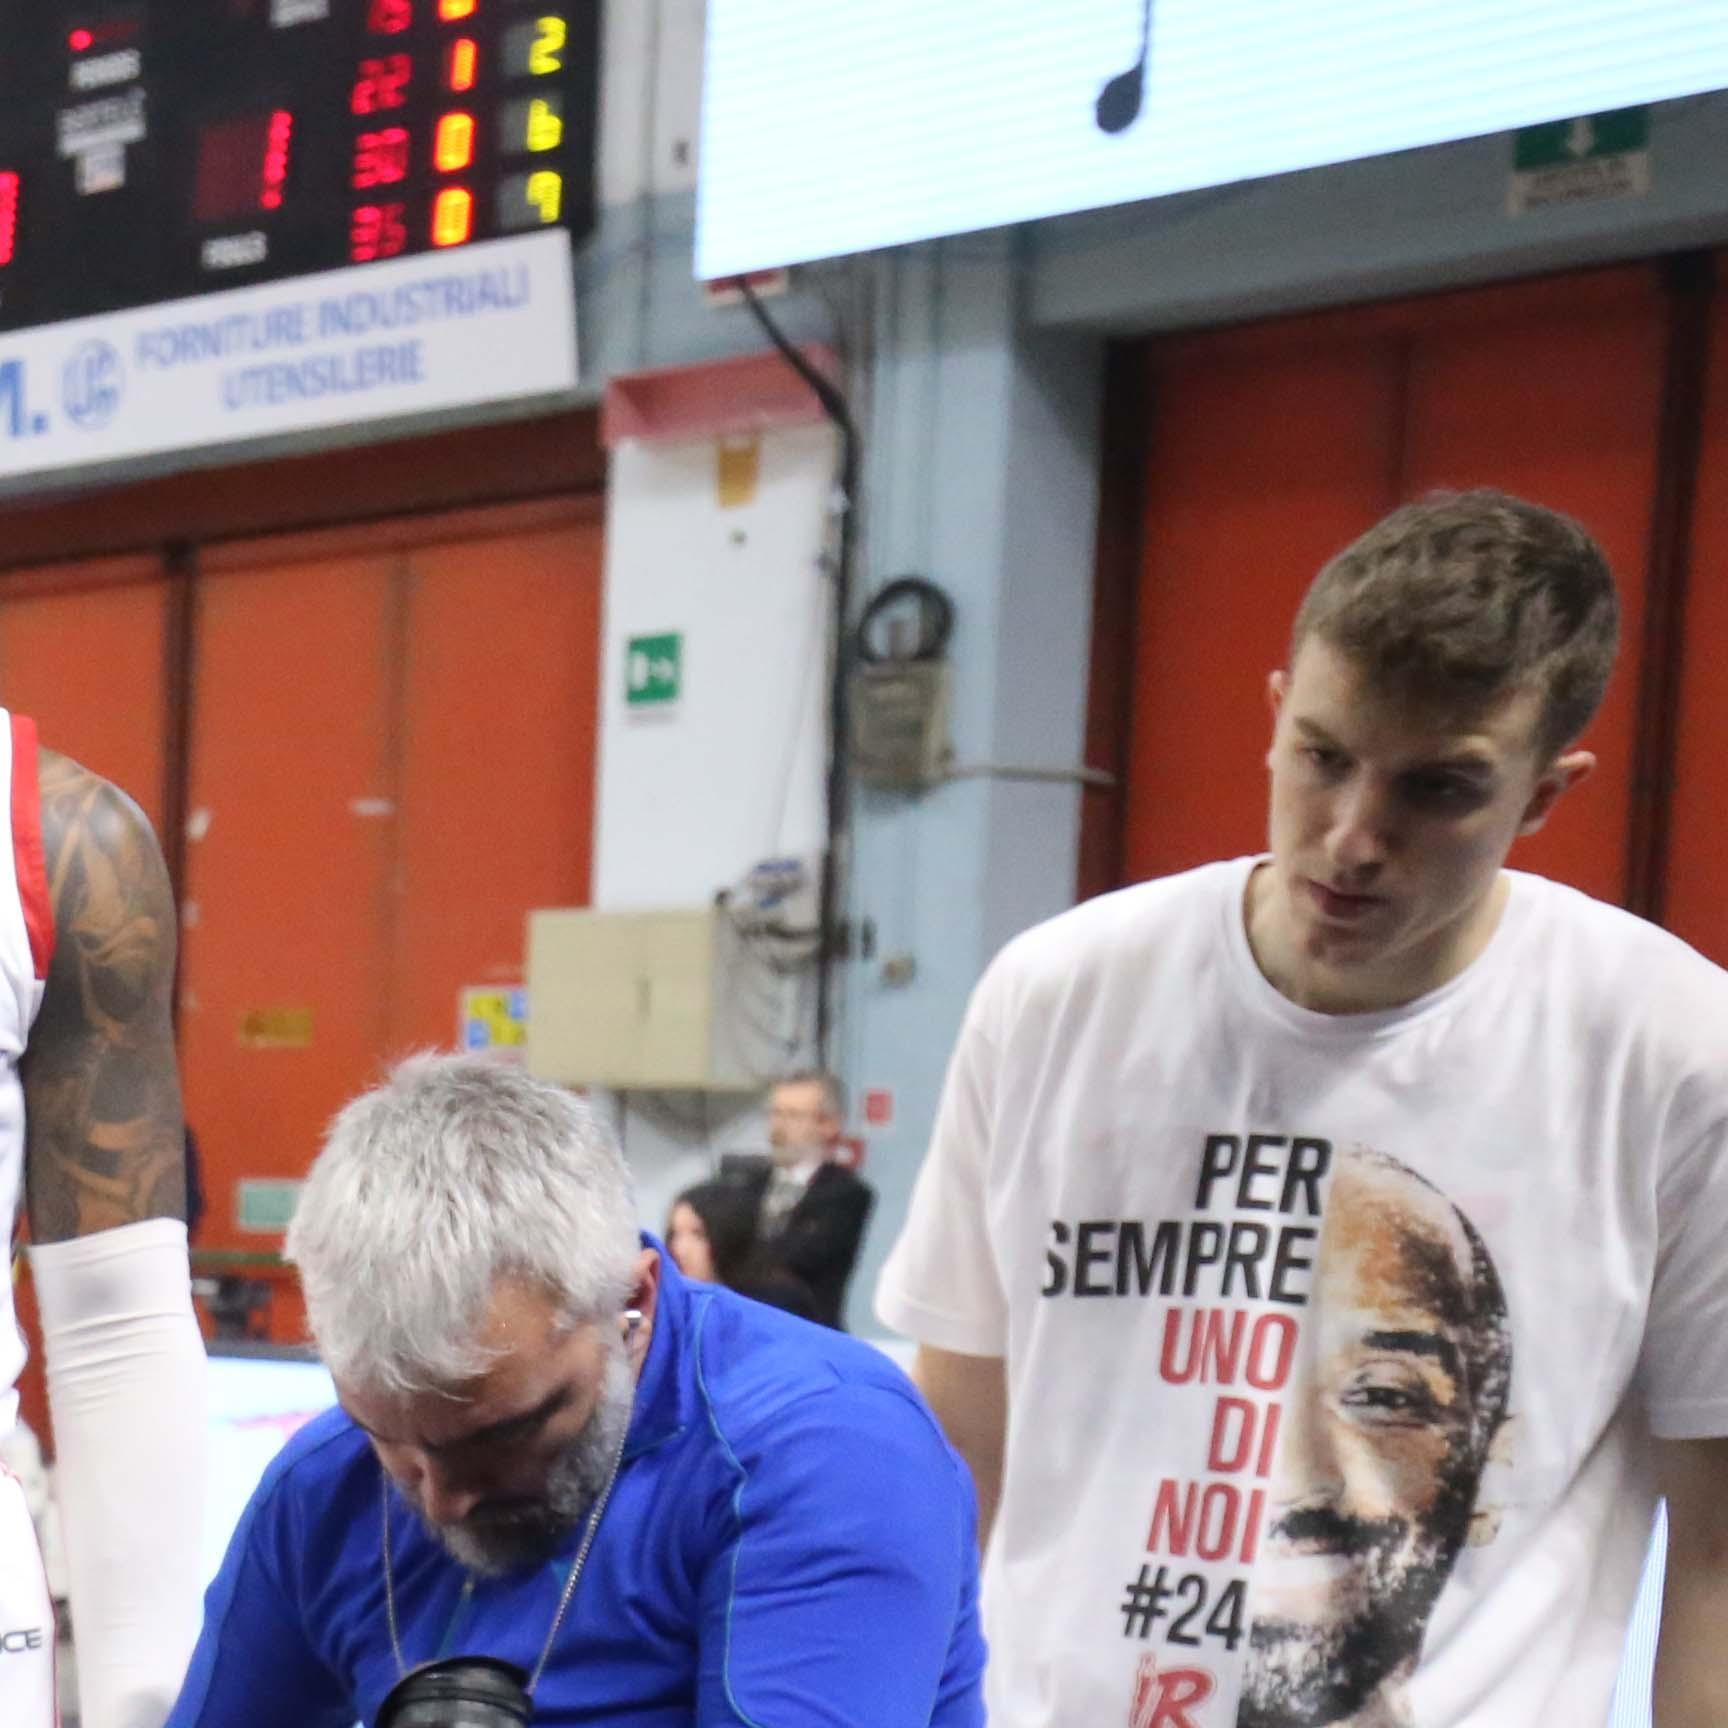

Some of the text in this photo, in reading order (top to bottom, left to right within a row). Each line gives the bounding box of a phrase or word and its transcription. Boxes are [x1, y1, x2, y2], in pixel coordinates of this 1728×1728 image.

[529, 16, 566, 75] 2
[260, 110, 293, 209] 1
[135, 264, 531, 370] FORNITURE INDUSTRIALI
[222, 339, 426, 412] UTENSILERIE
[1194, 1134, 1334, 1218] PER
[1041, 1219, 1320, 1306] SEMPRE
[1159, 1308, 1297, 1394] UNO
[1206, 1395, 1281, 1478] DI
[1145, 1478, 1270, 1566] NOI
[1120, 1562, 1249, 1653] #24
